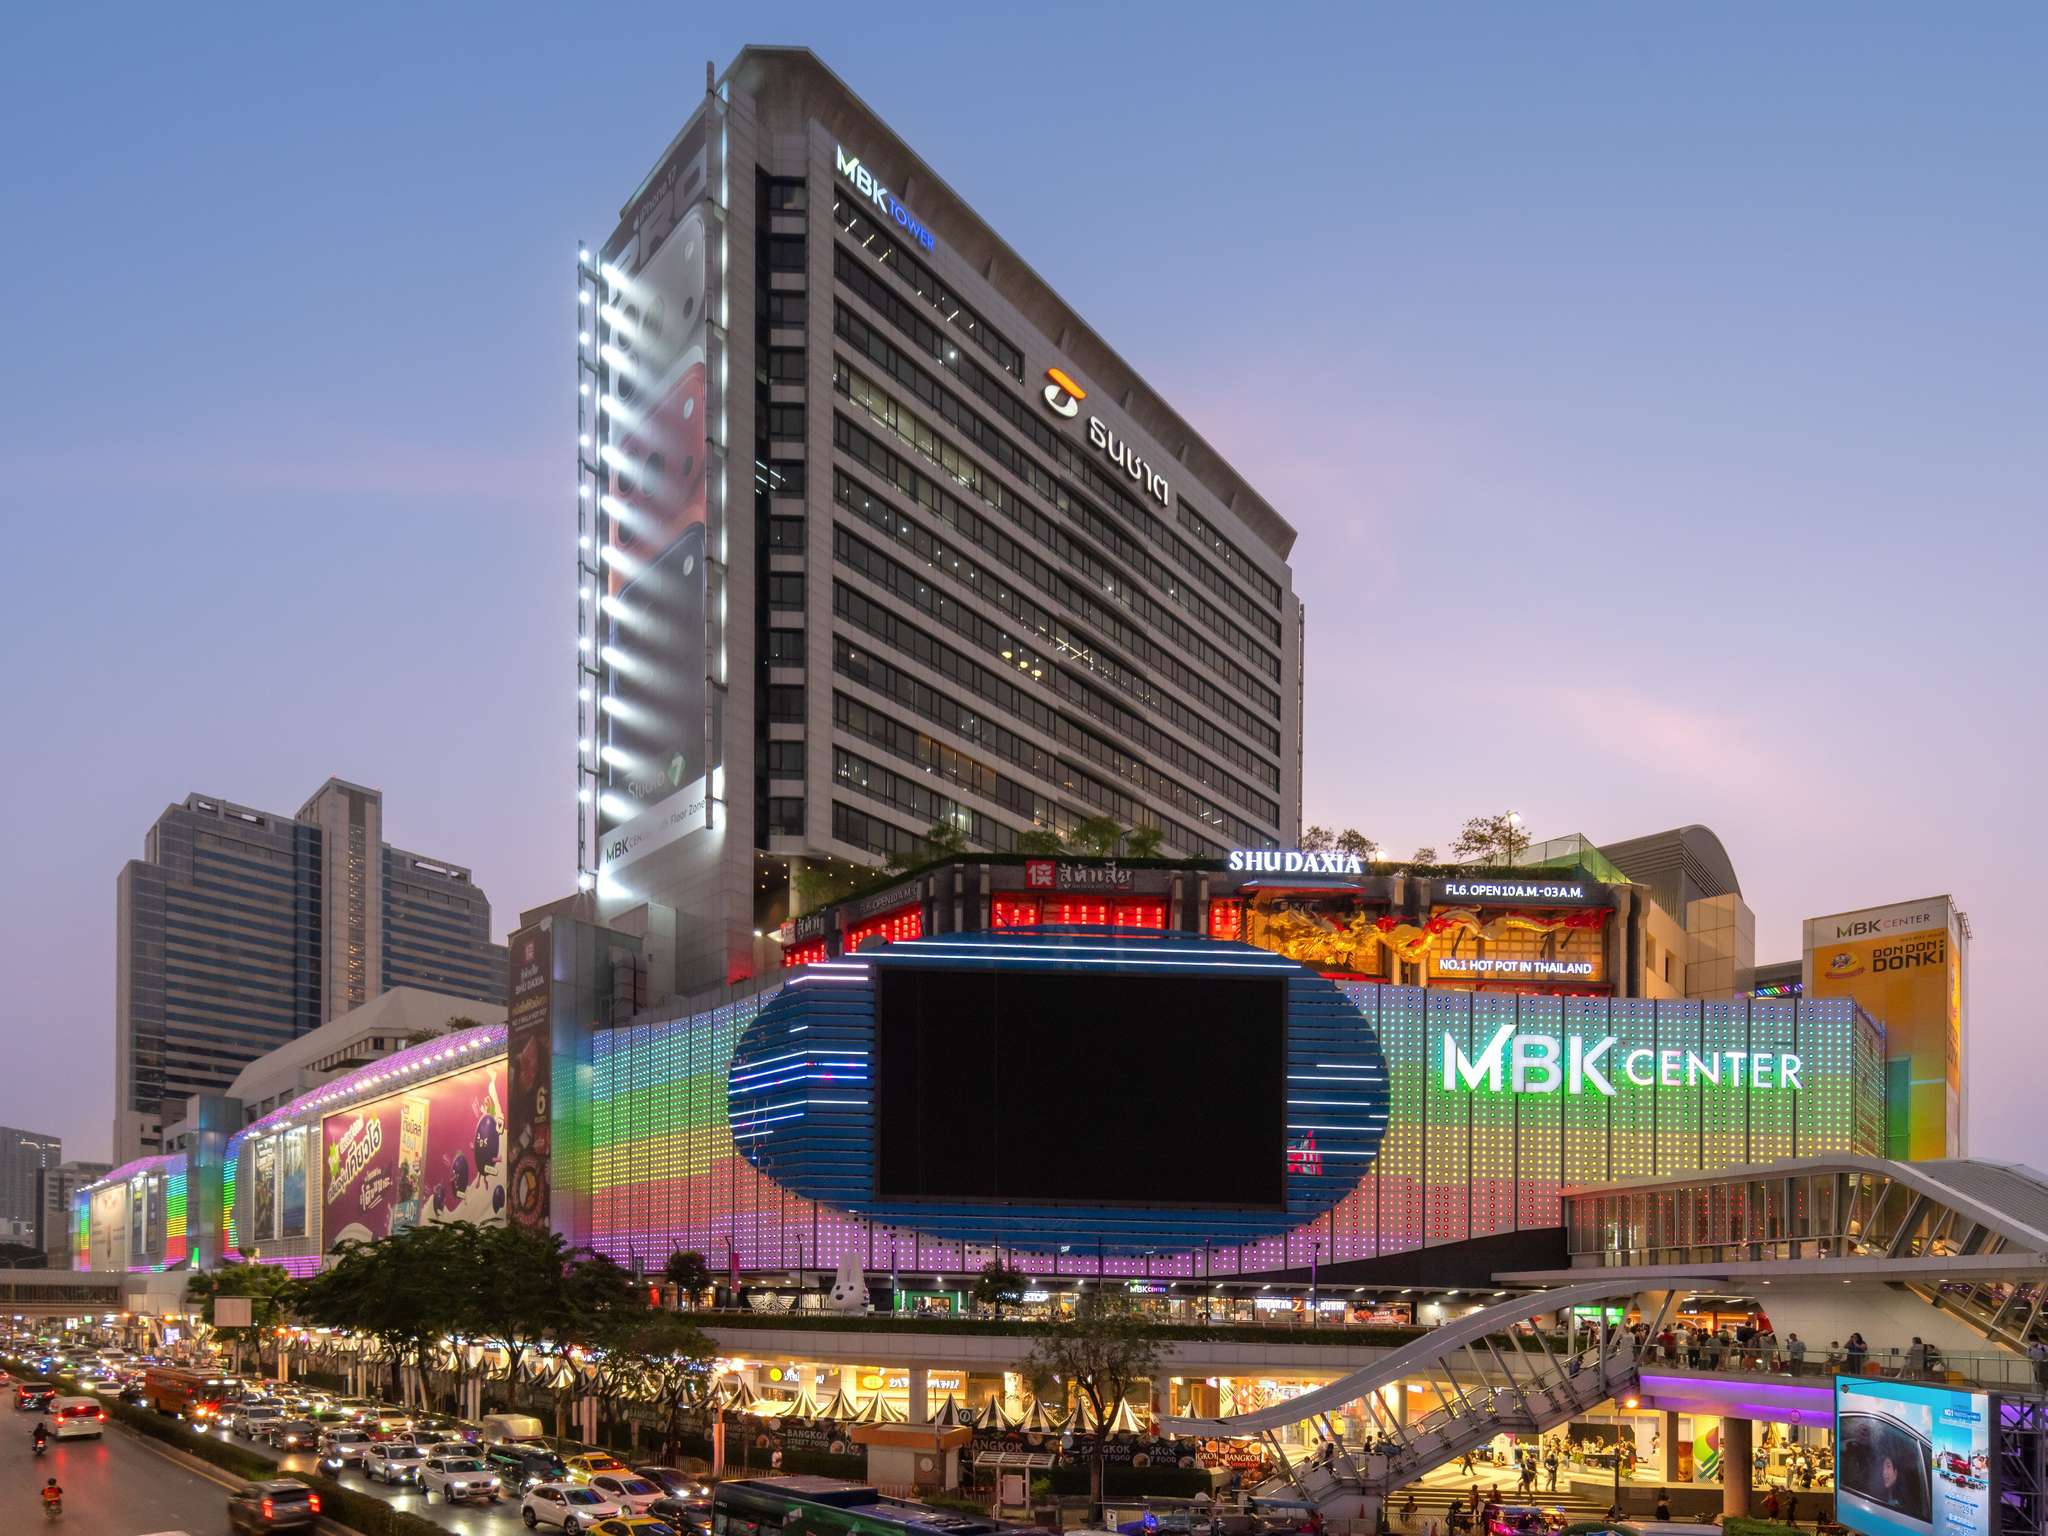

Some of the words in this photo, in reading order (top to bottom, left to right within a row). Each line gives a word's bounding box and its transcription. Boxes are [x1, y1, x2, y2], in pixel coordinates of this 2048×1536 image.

[836, 143, 888, 214] MBK
[888, 198, 936, 254] TOWER
[1089, 414, 1170, 508] ธนชาต
[606, 836, 629, 863] MBK
[1229, 850, 1281, 871] SHU
[1284, 851, 1362, 874] DAXIA
[1470, 884, 1501, 897] OPEN
[1837, 918, 1882, 939] MBK
[1881, 913, 1931, 929] CENTER
[1872, 945, 1904, 959] DON
[1905, 940, 1938, 954] DON
[1439, 959, 1467, 971] NO.1
[1469, 960, 1493, 971] HOT
[1495, 961, 1518, 972] POT
[1519, 962, 1532, 972] IN
[1533, 962, 1592, 975] THAILAND
[1442, 1023, 1618, 1096] MBK
[1624, 1048, 1805, 1090] CENTER
[1129, 1285, 1149, 1294] MBK
